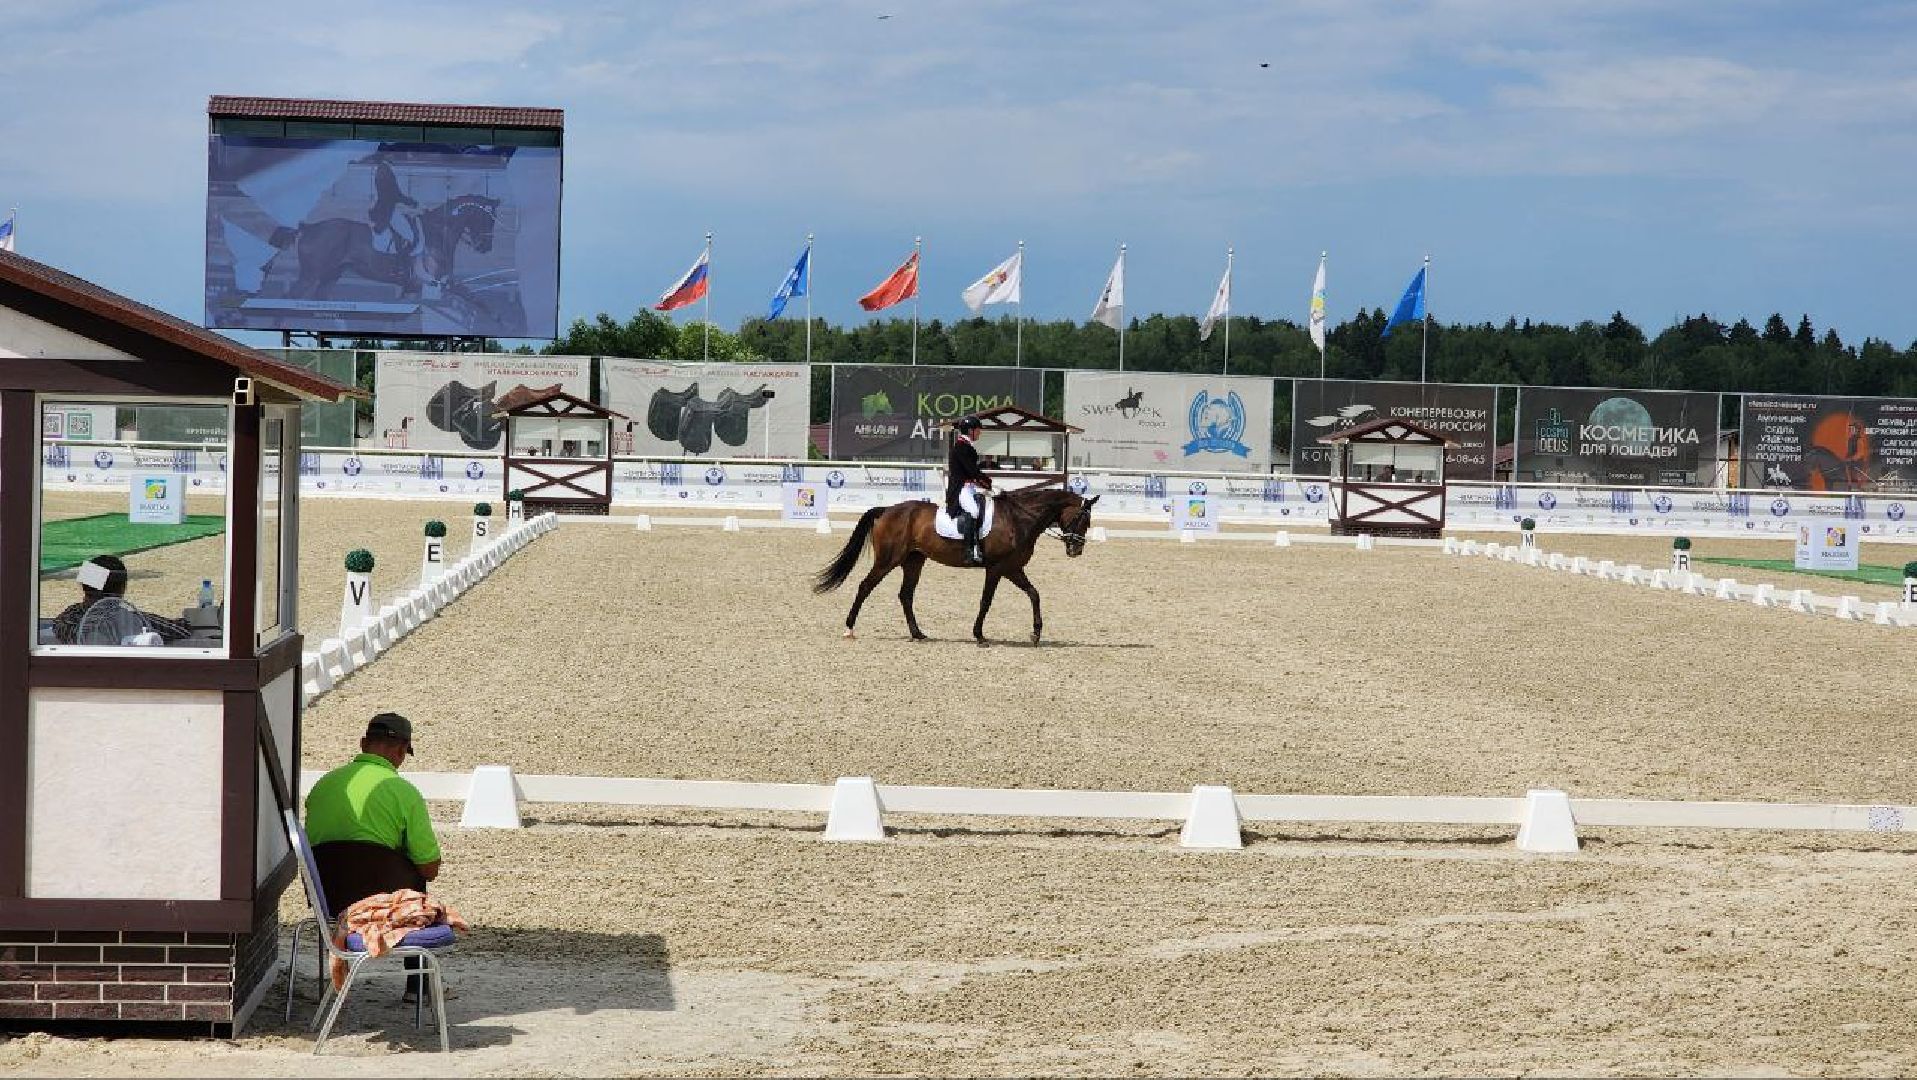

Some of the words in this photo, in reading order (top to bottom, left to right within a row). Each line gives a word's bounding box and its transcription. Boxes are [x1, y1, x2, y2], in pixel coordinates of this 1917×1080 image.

[918, 393, 1015, 416] КОРМА
[1390, 407, 1486, 419] КОНЕПЕРЕВОЗКИ
[1440, 422, 1486, 432] РОССИИ
[1580, 425, 1700, 444] КОСМЕТИКА
[1540, 438, 1569, 452] DEUS
[1580, 444, 1606, 455] ДЛЯ
[1611, 443, 1678, 457] ЛОШАДЕЙ
[511, 505, 521, 517] H
[476, 522, 486, 536] S
[1524, 533, 1534, 547] M
[428, 543, 441, 563] E
[1678, 554, 1689, 570] R
[350, 581, 366, 605] V
